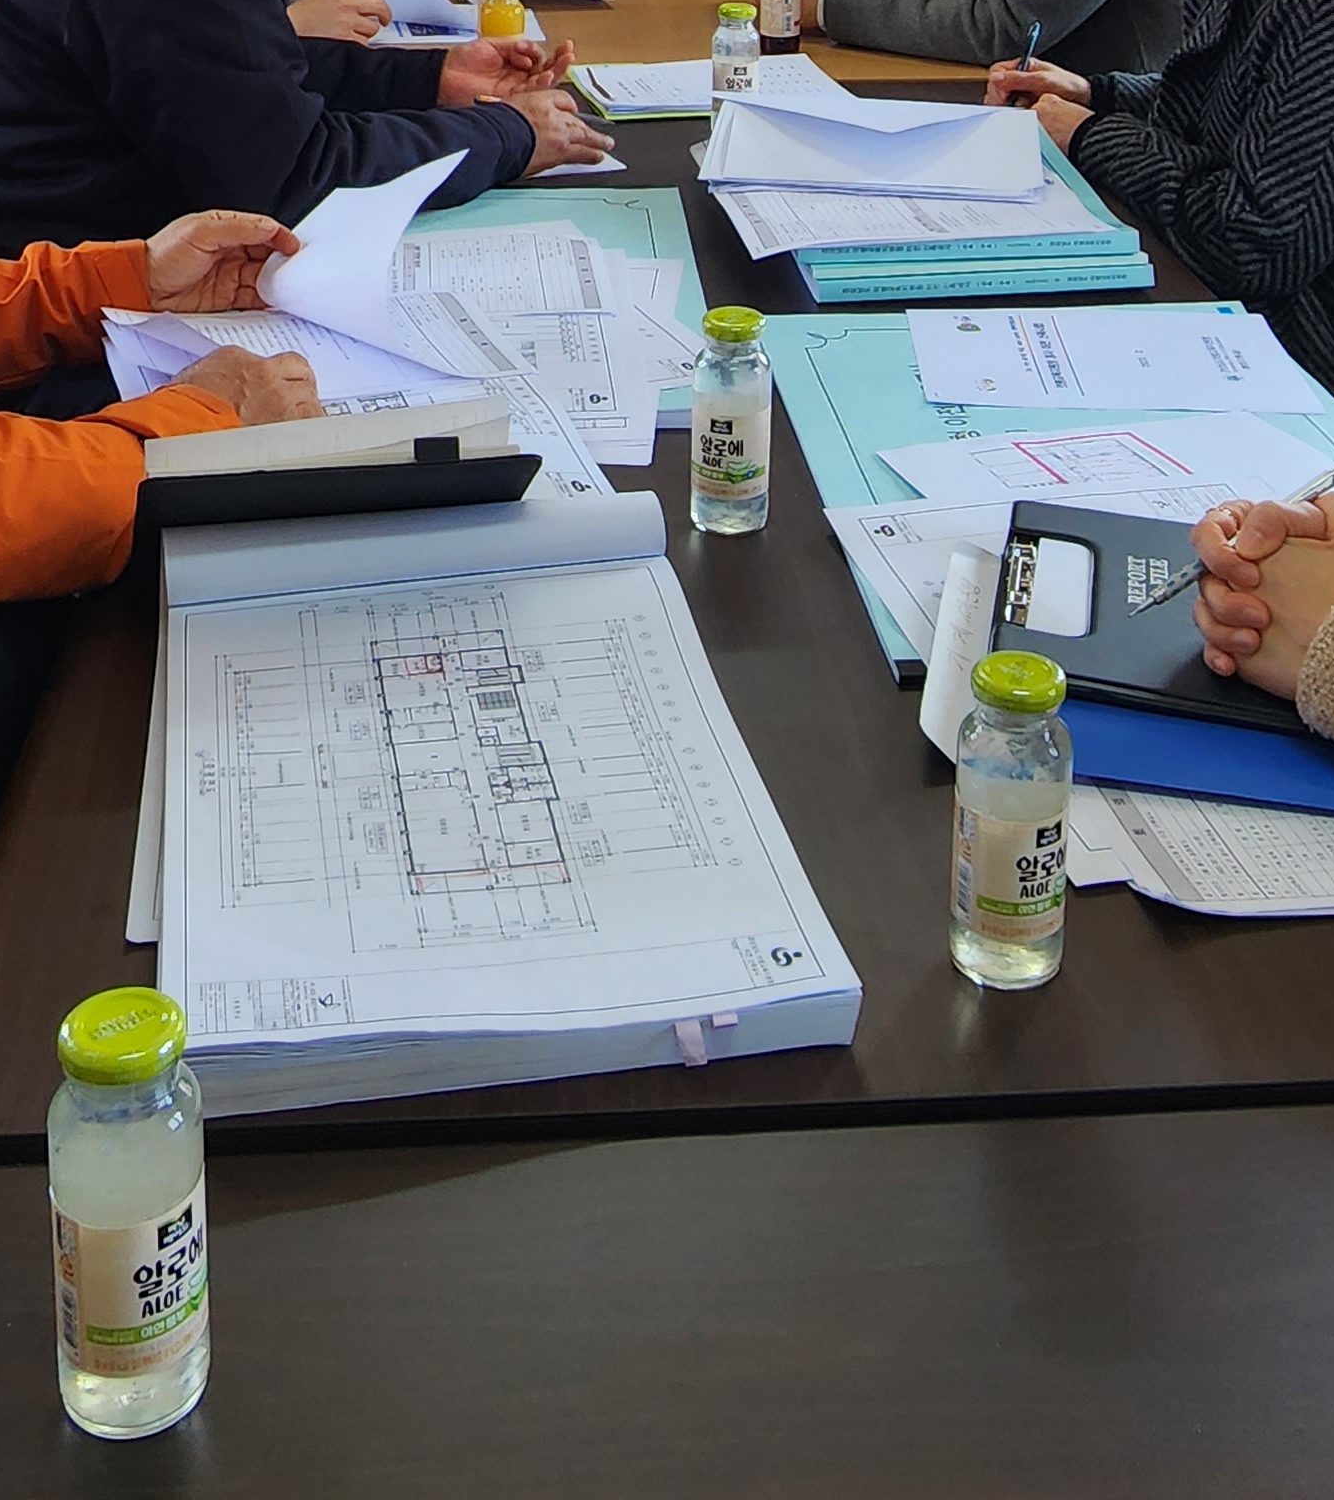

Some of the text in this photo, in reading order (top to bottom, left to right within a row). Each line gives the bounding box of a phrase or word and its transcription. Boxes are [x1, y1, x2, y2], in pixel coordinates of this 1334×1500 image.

[700, 434, 744, 458] 알로에
[1127, 554, 1147, 604] REPORT
[1149, 558, 1169, 586] FILE
[1019, 879, 1051, 899] ALOE
[132, 1222, 204, 1299] 알로에
[141, 1282, 185, 1319] ALOE
